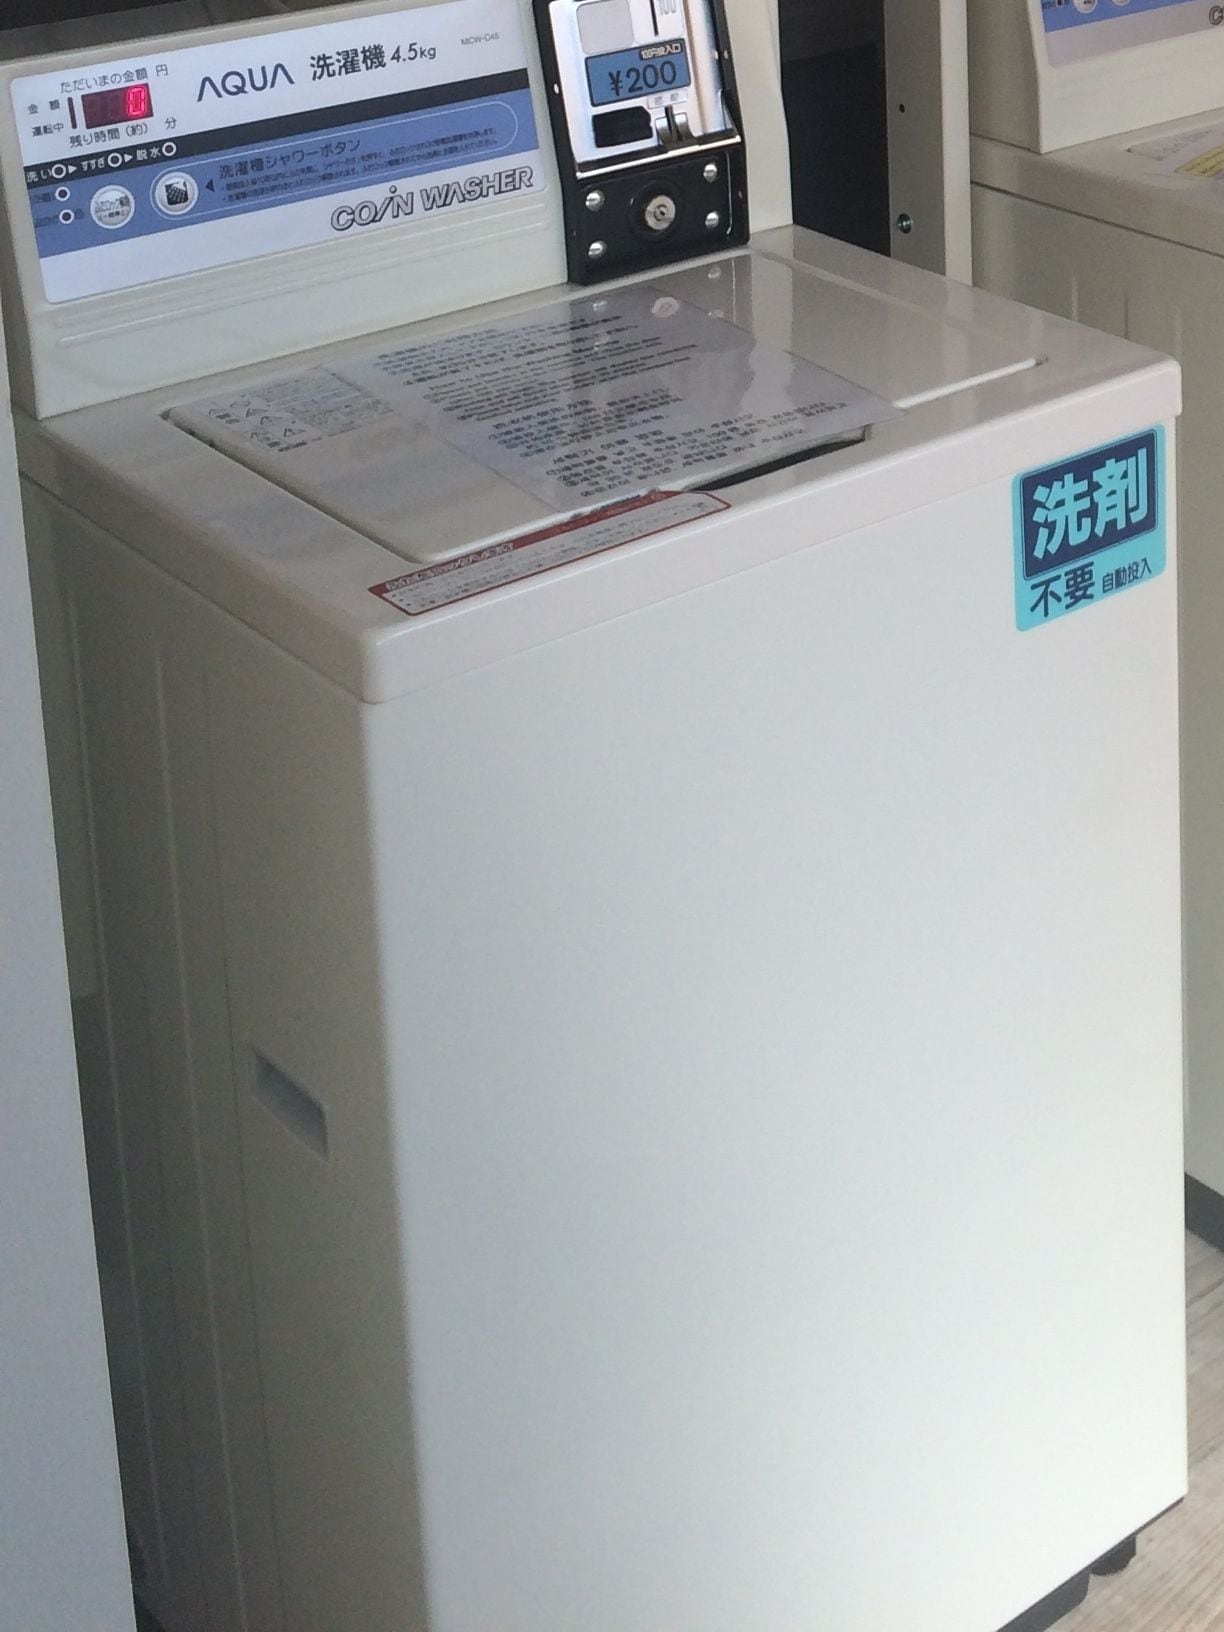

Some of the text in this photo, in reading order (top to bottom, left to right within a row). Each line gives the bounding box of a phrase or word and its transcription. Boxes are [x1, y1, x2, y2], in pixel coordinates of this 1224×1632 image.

[60, 64, 169, 93] ただいまの金額 円
[309, 43, 437, 81] 洗濯機 4.5kg
[608, 60, 677, 97] ¥200
[197, 62, 295, 102] AQUA
[128, 86, 147, 116] 0
[31, 123, 64, 138] 運転中
[165, 117, 177, 130] 分
[330, 166, 535, 231] COIN WASHER
[1033, 447, 1148, 559] 洗剤
[1030, 557, 1152, 617] 不要 自動投入
